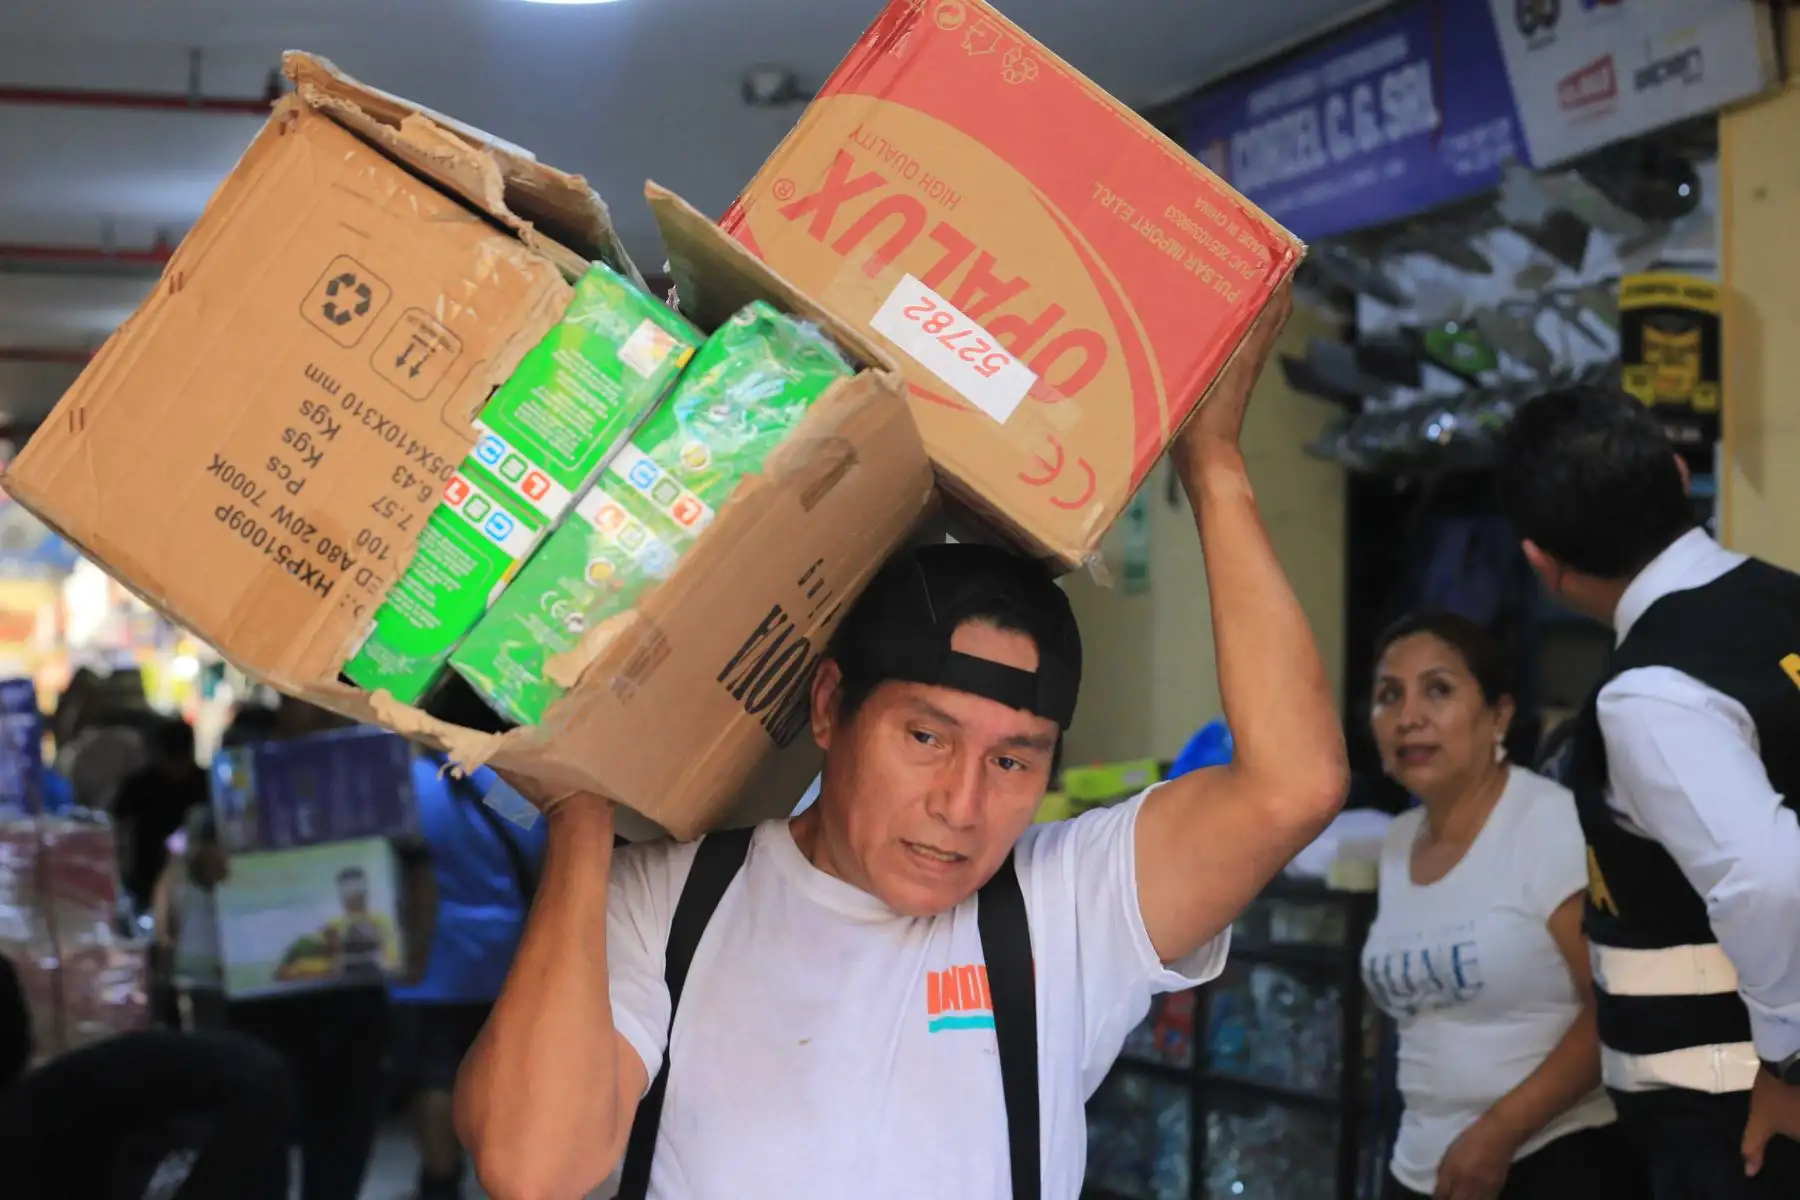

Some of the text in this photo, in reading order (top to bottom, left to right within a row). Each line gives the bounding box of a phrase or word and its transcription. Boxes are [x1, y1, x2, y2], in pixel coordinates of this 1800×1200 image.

[847, 123, 963, 211] HIGH QUALITY
[1130, 215, 1187, 261] IMPORT
[1194, 197, 1270, 260] MADE IN CHINA
[1227, 254, 1257, 280] RUC
[776, 145, 1109, 404] OPALUX
[1183, 252, 1242, 303] PULSAR
[303, 363, 342, 396] mm
[902, 296, 1010, 378] 52782
[281, 427, 415, 532] 7.57 Kgs
[298, 399, 433, 503] 6.43 Kgs
[340, 392, 456, 482] 05X410X310
[1017, 436, 1098, 511] CE
[206, 453, 384, 594] ED A80 20W 7000K
[214, 503, 336, 599] HXP51009P
[265, 456, 391, 561] 100 Pcs
